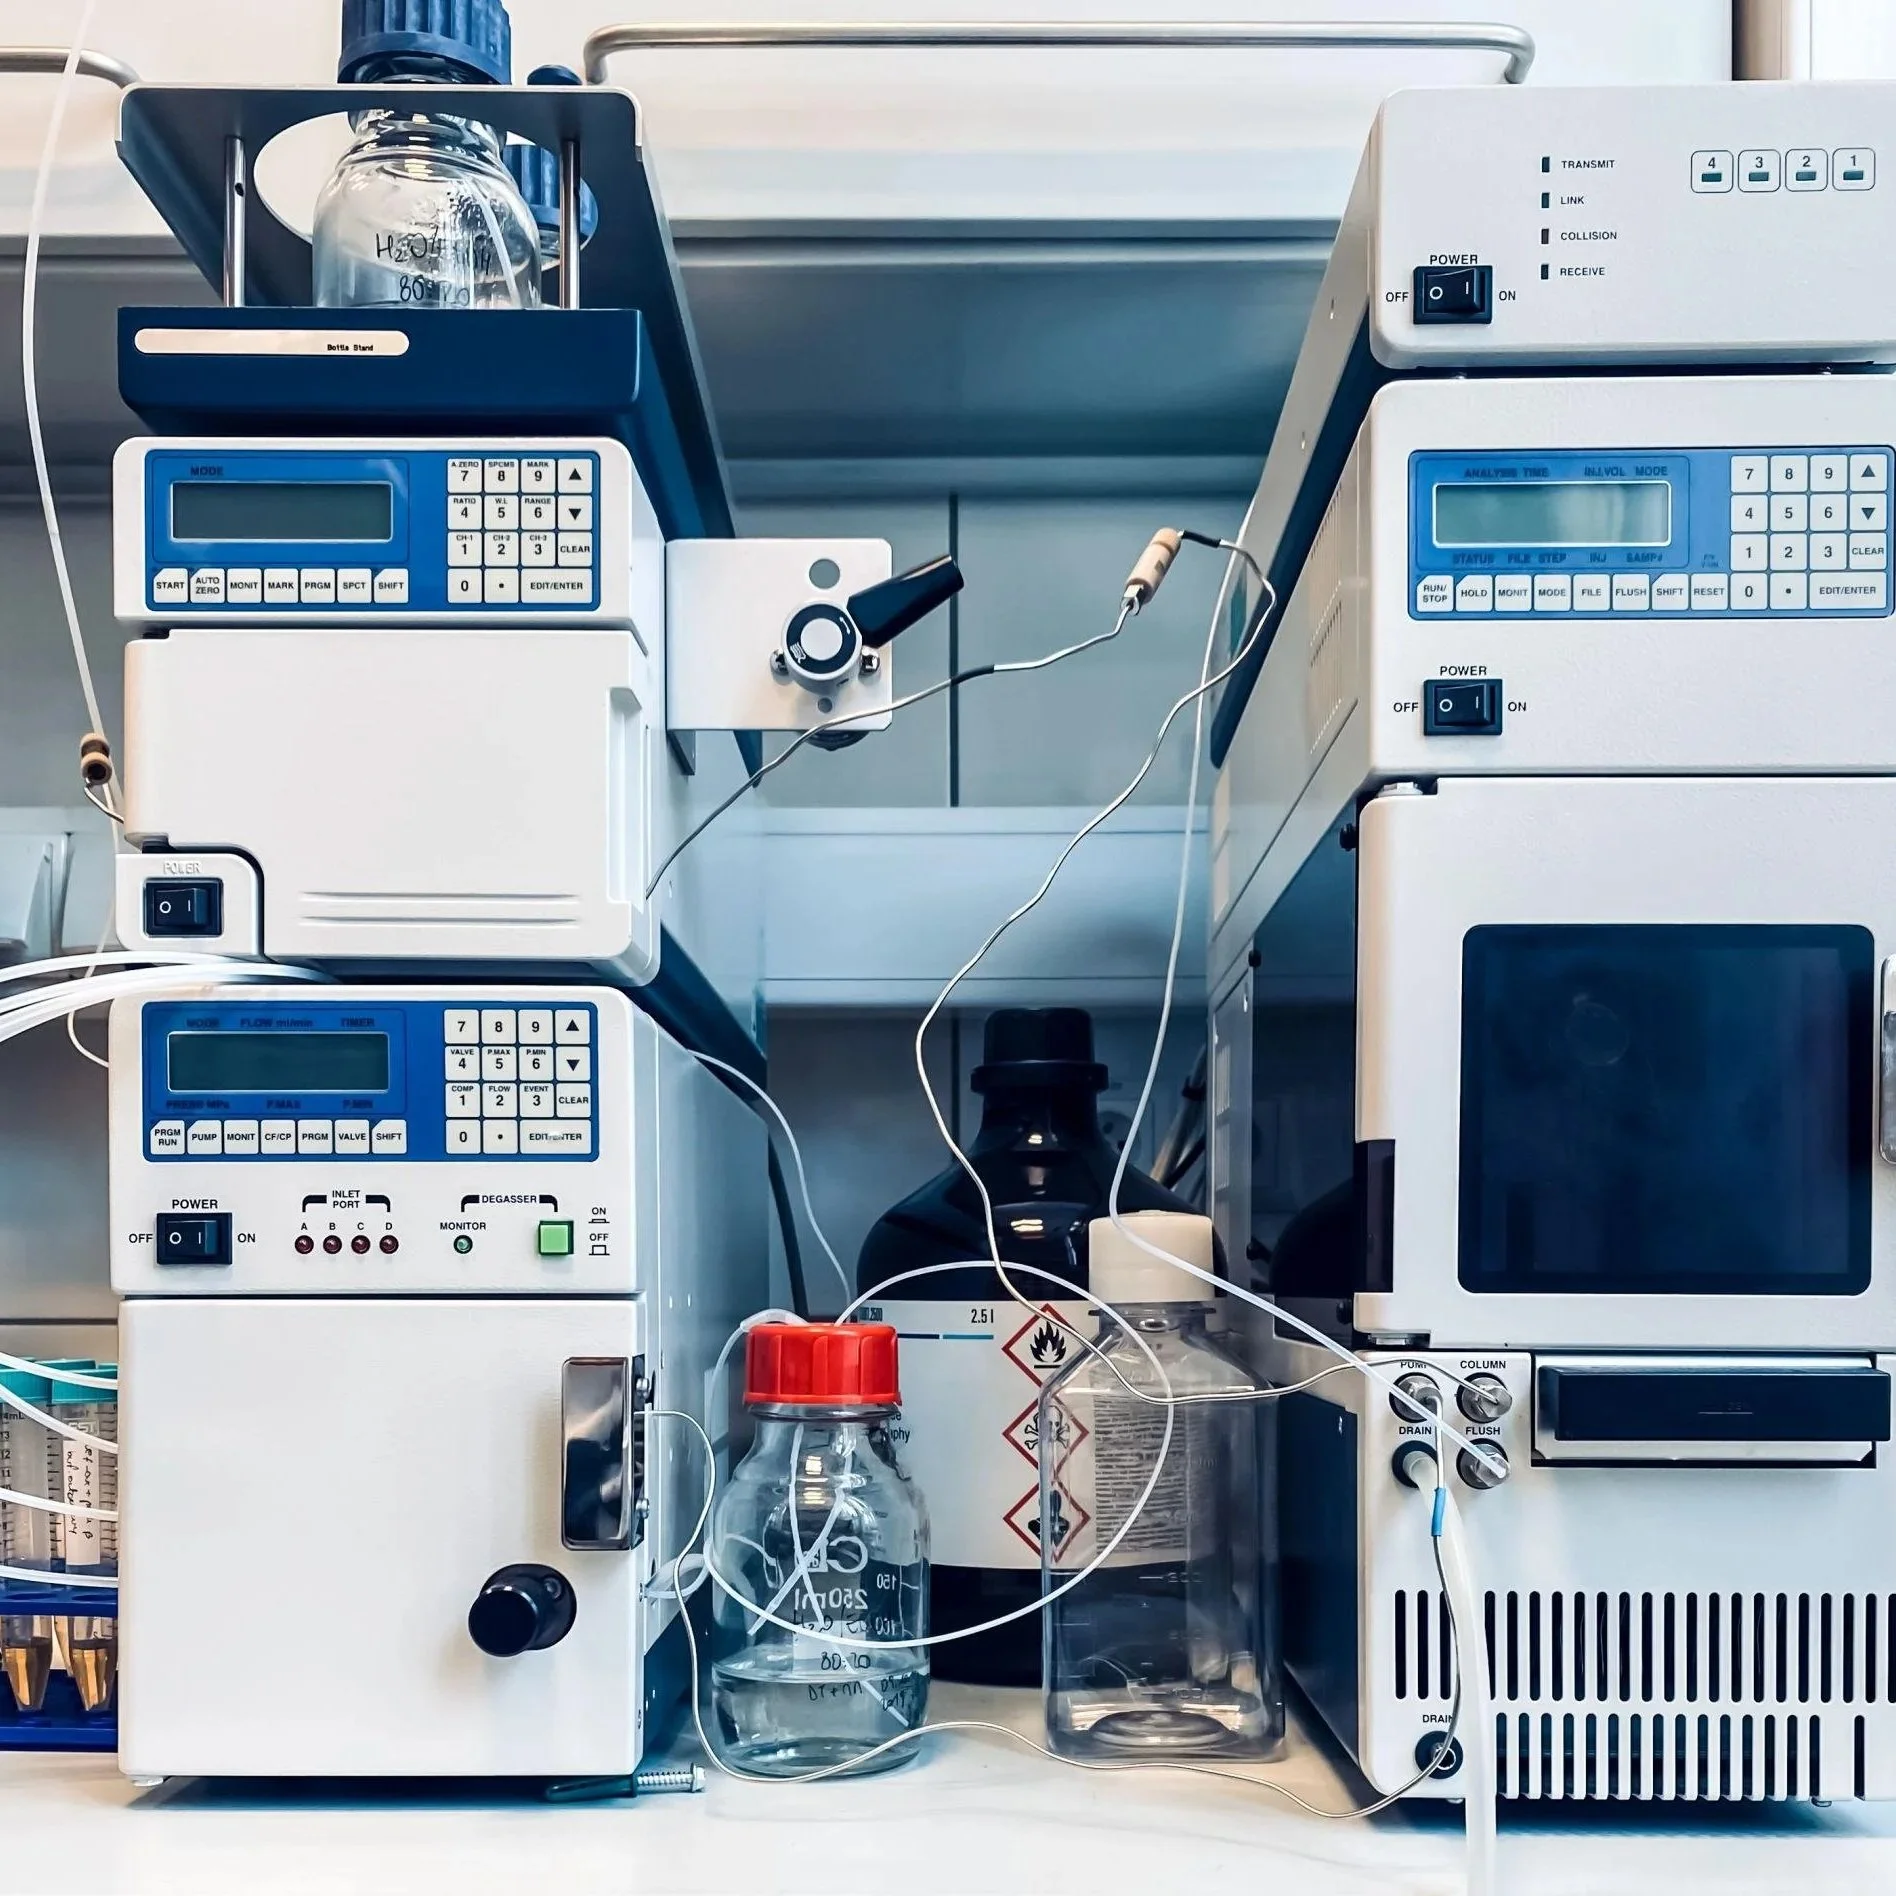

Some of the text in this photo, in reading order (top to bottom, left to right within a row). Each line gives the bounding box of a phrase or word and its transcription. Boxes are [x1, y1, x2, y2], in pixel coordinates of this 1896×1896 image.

[1561, 159, 1615, 169] TRANSMIT
[1707, 156, 1716, 169] 4
[1755, 156, 1764, 169] 3
[1802, 155, 1811, 168] 2
[1850, 154, 1856, 167] 1
[1560, 195, 1585, 205] LINK
[1560, 231, 1618, 241] COLLISION
[1429, 254, 1479, 265] POWER
[1559, 267, 1605, 277] RECEIVE
[1385, 291, 1409, 303] OFF
[1498, 290, 1516, 301] ON
[460, 470, 469, 482] 7
[497, 470, 506, 482] 8
[534, 470, 543, 482] 9
[1523, 467, 1549, 477] TIME
[1635, 466, 1668, 476] MODE
[1744, 468, 1754, 480] 7
[1784, 467, 1794, 480] 8
[1824, 467, 1833, 480] 9
[524, 497, 551, 505] RANGE
[460, 506, 469, 519] 4
[497, 506, 506, 519] 5
[534, 506, 543, 519] 6
[1744, 507, 1753, 520] 4
[1784, 506, 1793, 519] 5
[1824, 506, 1833, 519] 6
[462, 543, 467, 555] 1
[497, 543, 506, 555] 2
[534, 543, 543, 555] 3
[560, 545, 591, 553] CLEAR
[1746, 546, 1752, 559] 1
[1784, 546, 1793, 558] 2
[1824, 545, 1833, 558] 3
[1851, 547, 1885, 556] CLEAR
[1539, 553, 1566, 563] STEP
[1590, 553, 1607, 563] INJ
[156, 581, 185, 590] START
[195, 576, 220, 585] AUTO
[229, 581, 258, 590] MONIT
[267, 581, 294, 589] MARK
[304, 581, 331, 590] PRGM
[342, 581, 366, 590] SPCT
[378, 581, 404, 590] SHIFT
[195, 586, 220, 595] ZERO
[460, 580, 469, 592] 0
[530, 582, 583, 590] EDIT/ENTER
[1423, 584, 1447, 593] RUN/
[1819, 586, 1876, 595] EDIT/ENTER
[1460, 589, 1488, 598] HOLD
[1498, 588, 1528, 597] MONIT
[1538, 588, 1566, 597] MODE
[1581, 588, 1602, 597] FILE
[1615, 588, 1647, 597] FLUSH
[1656, 587, 1683, 596] SHIFT
[1693, 587, 1725, 596] RESET
[1744, 585, 1754, 598] 0
[1422, 594, 1448, 603] STOP
[1439, 665, 1487, 676] POWER
[1393, 701, 1419, 713] OFF
[1507, 701, 1527, 712] ON
[457, 1020, 466, 1033] 7
[494, 1021, 503, 1033] 8
[531, 1021, 540, 1033] 9
[450, 1048, 474, 1056] VALVE
[526, 1048, 546, 1056] P.MIN
[458, 1057, 467, 1069] 4
[495, 1057, 504, 1070] 5
[532, 1057, 541, 1070] 6
[488, 1085, 511, 1093] FLOW
[523, 1085, 549, 1093] EVENT
[459, 1094, 465, 1106] 1
[495, 1094, 504, 1107] 2
[532, 1094, 541, 1107] 3
[558, 1096, 589, 1105] CLEAR
[152, 1128, 181, 1137] PRGM
[191, 1133, 218, 1141] PUMP
[226, 1132, 256, 1141] MONIT
[264, 1132, 292, 1141] CF/CP
[301, 1132, 329, 1141] PRGM
[338, 1132, 366, 1141] VALVE
[375, 1132, 402, 1141] SHIFT
[459, 1131, 468, 1143] 0
[158, 1138, 178, 1146] RUN
[332, 1189, 361, 1199] INLET
[481, 1194, 537, 1204] DEGASSER
[171, 1198, 218, 1210] POWER
[332, 1200, 361, 1209] PORT
[591, 1206, 607, 1216] ON
[300, 1222, 308, 1231] A
[329, 1222, 336, 1231] B
[356, 1221, 365, 1231] C
[385, 1222, 393, 1231] D
[439, 1221, 487, 1231] MONITOR
[129, 1234, 153, 1243] OFF
[237, 1232, 256, 1243] ON
[589, 1232, 609, 1242] OFF
[971, 1309, 987, 1323] 2.5
[1459, 1360, 1507, 1369] COLUMN
[1398, 1426, 1432, 1435] DRAIN
[1465, 1426, 1501, 1436] FLUSH
[1, 1450, 10, 1459] 12
[2, 1469, 11, 1477] 11
